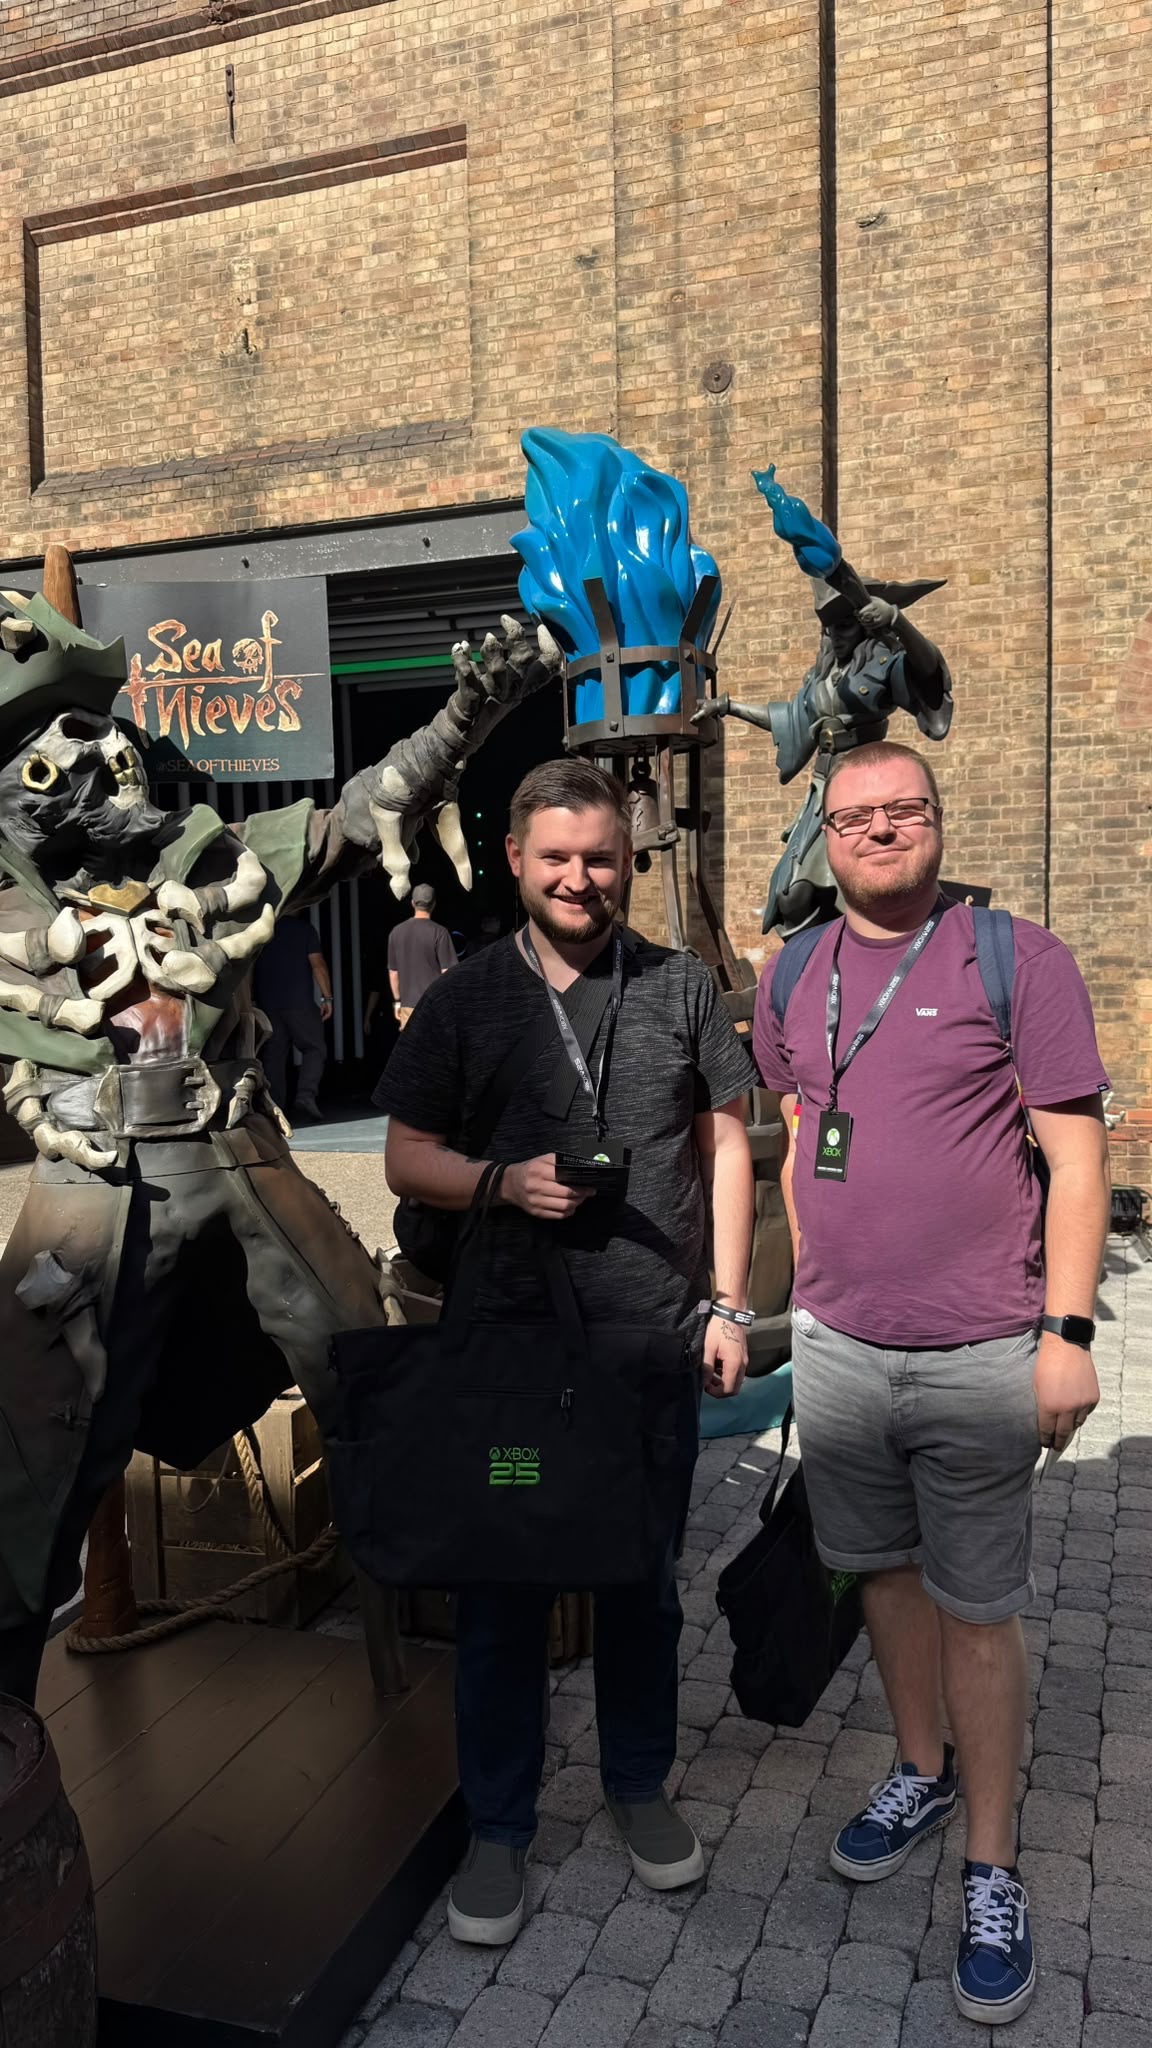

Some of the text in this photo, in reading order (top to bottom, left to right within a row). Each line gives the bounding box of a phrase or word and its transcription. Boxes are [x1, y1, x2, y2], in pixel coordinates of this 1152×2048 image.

[145, 619, 226, 674] Sea
[915, 1007, 939, 1017] VANS
[822, 1146, 842, 1157] XBOX
[502, 1447, 540, 1460] XBOX
[488, 1462, 541, 1485] 25
